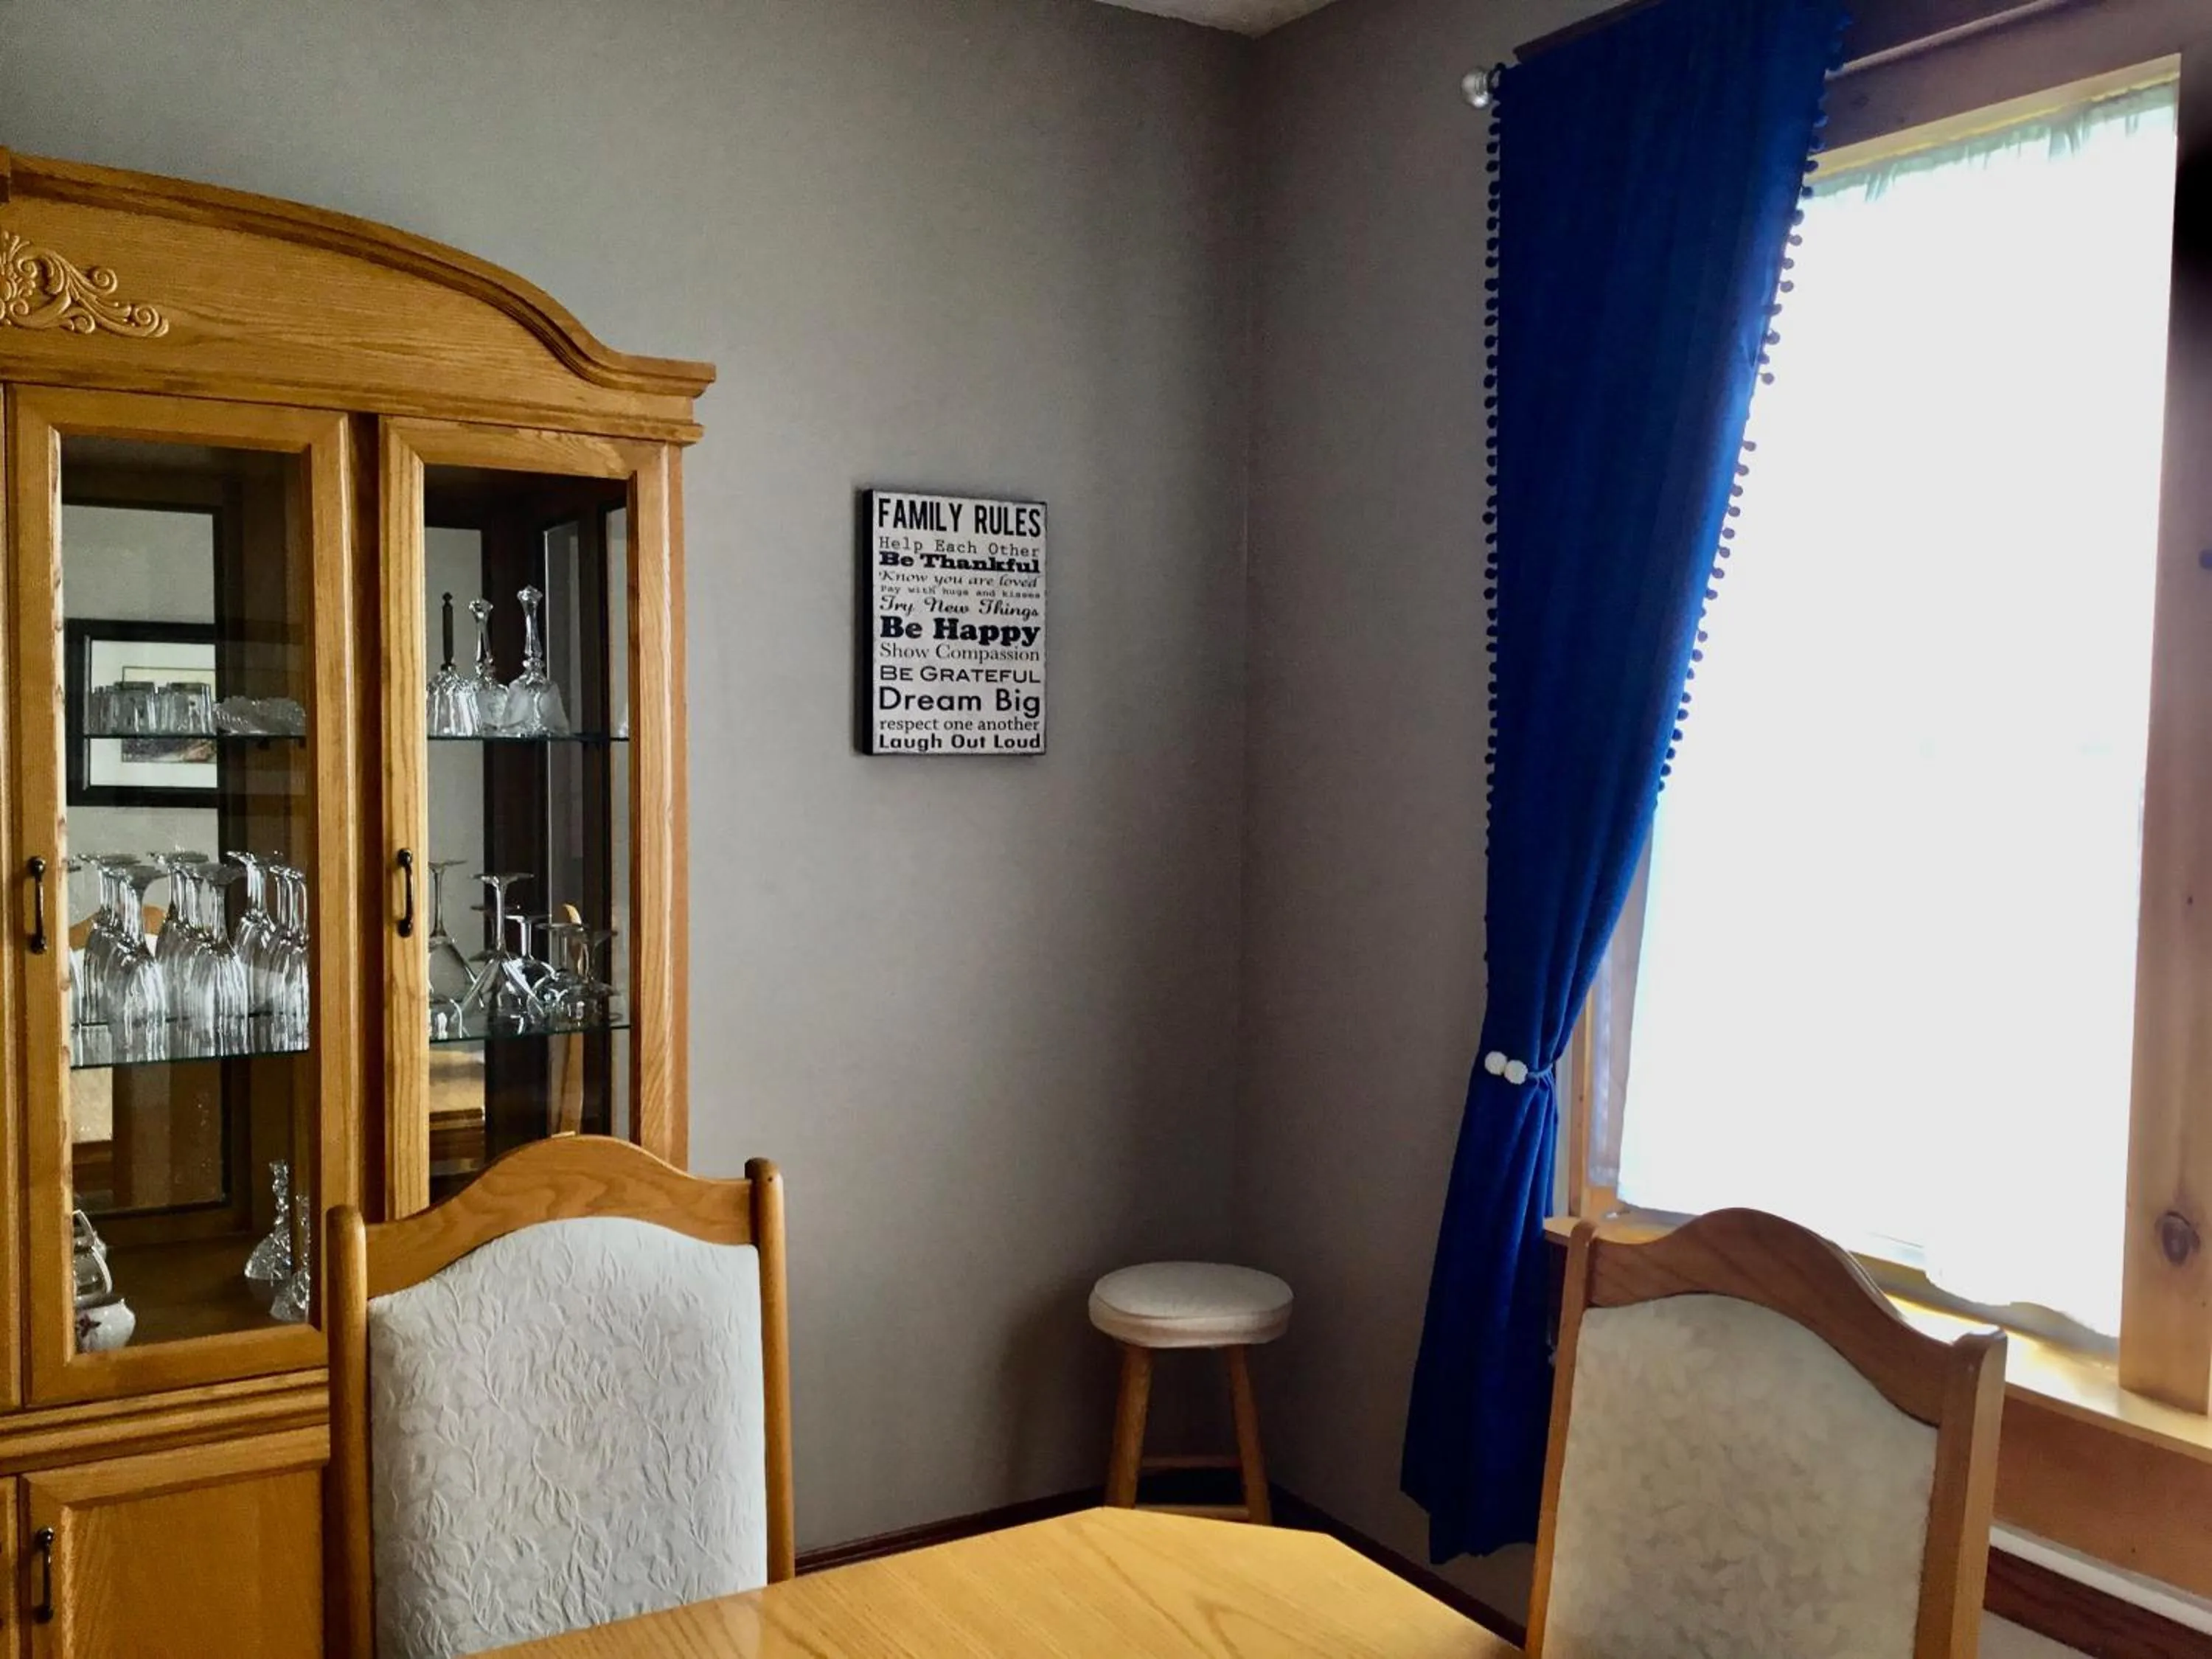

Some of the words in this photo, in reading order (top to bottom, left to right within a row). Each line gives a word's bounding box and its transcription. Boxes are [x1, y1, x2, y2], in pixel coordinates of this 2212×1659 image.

[879, 498, 962, 532] FAMILY
[975, 505, 1040, 537] RULES
[879, 537, 922, 553] Help
[935, 540, 977, 554] Each
[989, 543, 1040, 557] Other
[879, 552, 914, 567] Be
[920, 554, 1040, 573] Thankful
[879, 571, 928, 582] Know
[934, 576, 962, 585] you
[969, 577, 995, 585] are
[999, 574, 1038, 588] loved
[880, 596, 913, 616] Try
[925, 597, 969, 613] New
[979, 599, 1038, 621] Things
[880, 616, 922, 638] Be
[933, 618, 1040, 647] Happy
[880, 643, 929, 658] Show
[936, 643, 1040, 664] Compassion
[880, 665, 913, 681] BE
[920, 666, 1040, 683] GRATEFUL
[880, 686, 981, 711] Dream
[996, 689, 1040, 718] Big
[880, 719, 939, 733] respect
[944, 720, 973, 731] one
[978, 717, 1040, 731] another
[880, 733, 942, 751] Laugh
[951, 734, 985, 748] Out
[994, 733, 1040, 748] Loud
